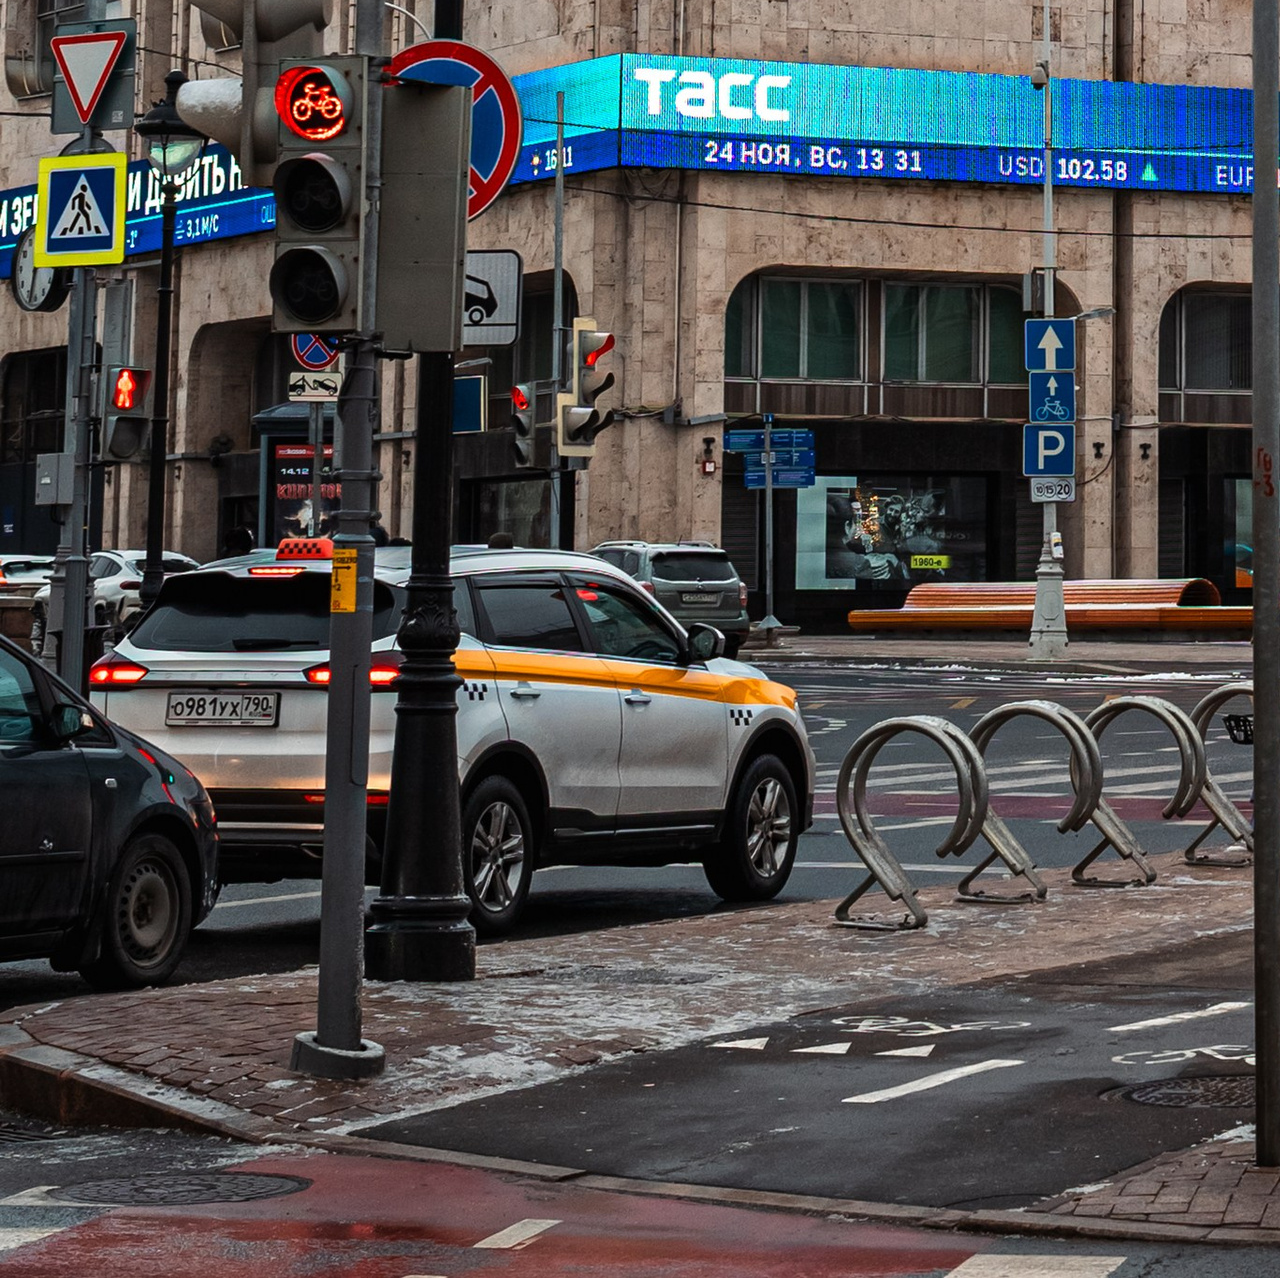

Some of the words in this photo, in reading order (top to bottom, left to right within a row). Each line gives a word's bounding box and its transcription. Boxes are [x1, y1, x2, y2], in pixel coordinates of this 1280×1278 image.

[704, 140, 735, 163] 24
[1057, 158, 1127, 181] 102.58
[1038, 430, 1065, 469] P
[1045, 485, 1054, 494] 15
[1057, 484, 1070, 495] 20
[244, 697, 270, 712] 790
